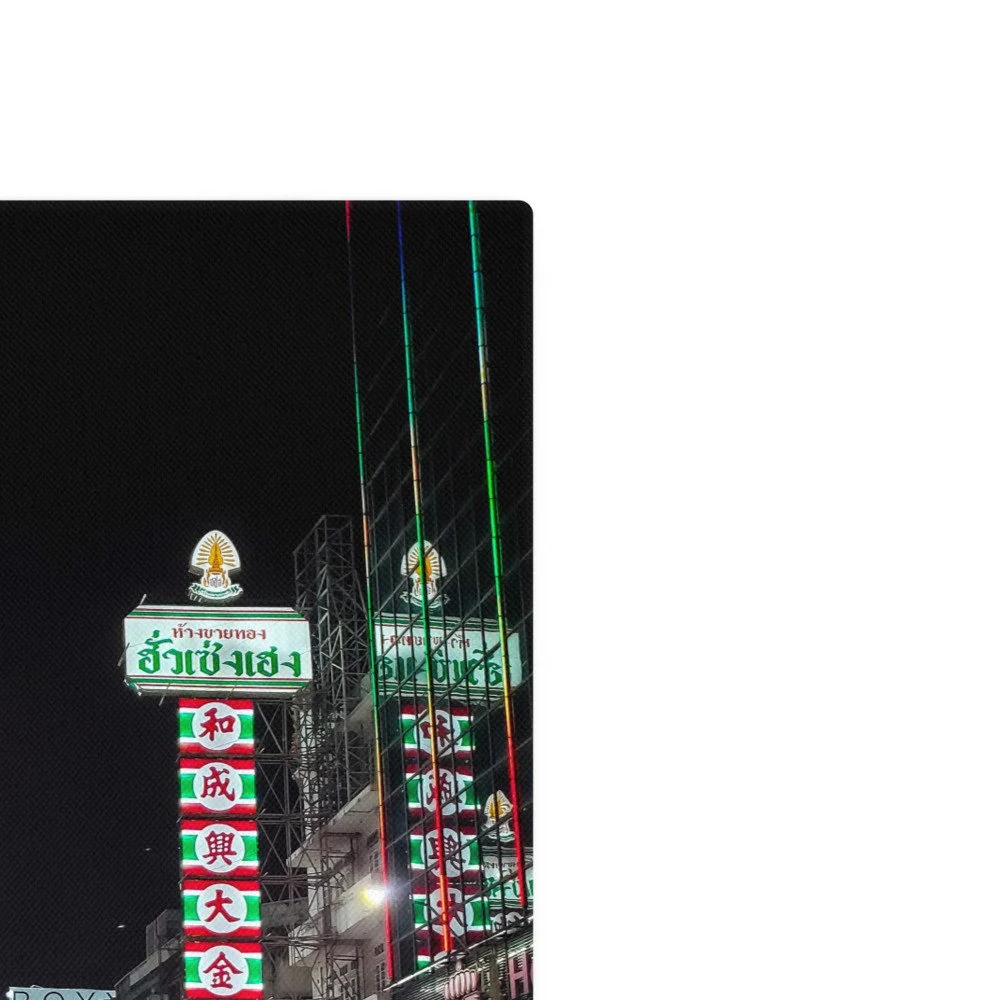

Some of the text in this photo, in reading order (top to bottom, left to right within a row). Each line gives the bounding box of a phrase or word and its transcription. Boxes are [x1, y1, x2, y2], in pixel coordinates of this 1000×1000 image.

[171, 622, 267, 640] ห้างขายทอง
[137, 629, 302, 678] ฮั่วเซ่งเฮง
